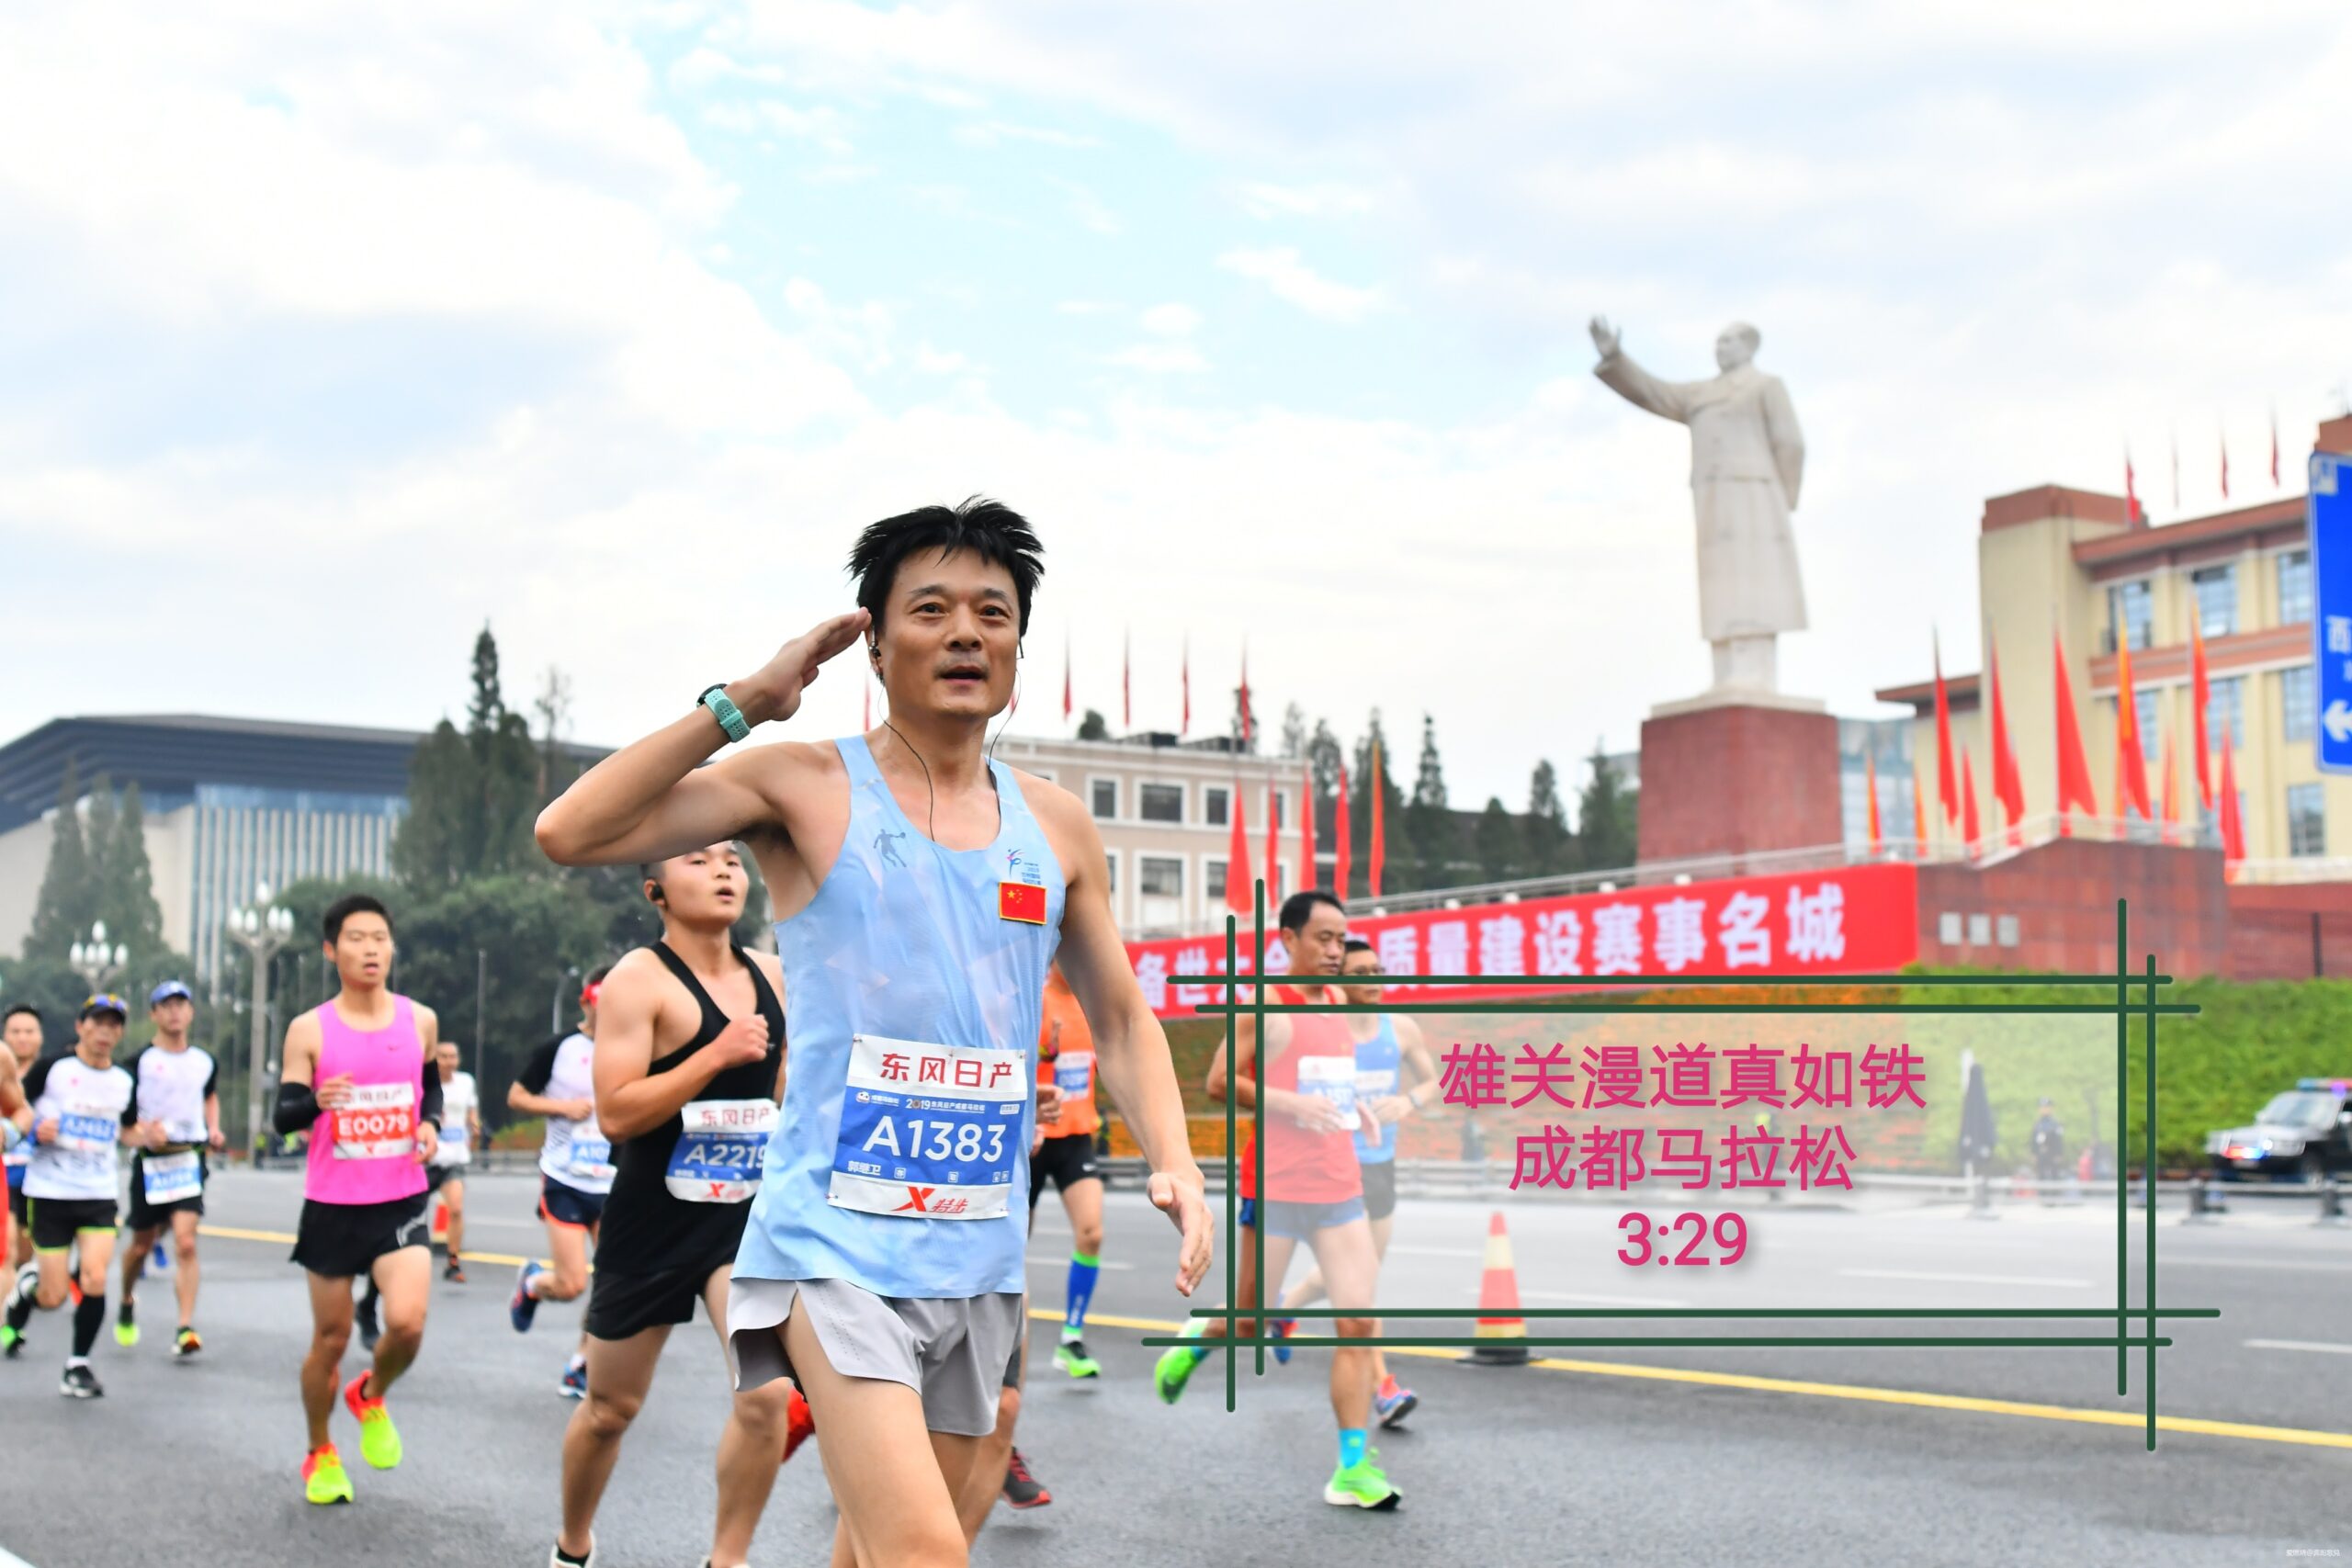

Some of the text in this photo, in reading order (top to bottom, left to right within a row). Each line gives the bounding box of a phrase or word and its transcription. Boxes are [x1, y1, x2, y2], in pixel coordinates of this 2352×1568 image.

[1345, 882, 1846, 992] 质量建设赛事名城
[879, 1053, 1012, 1089] 东风日产
[862, 1115, 1007, 1163] A1383
